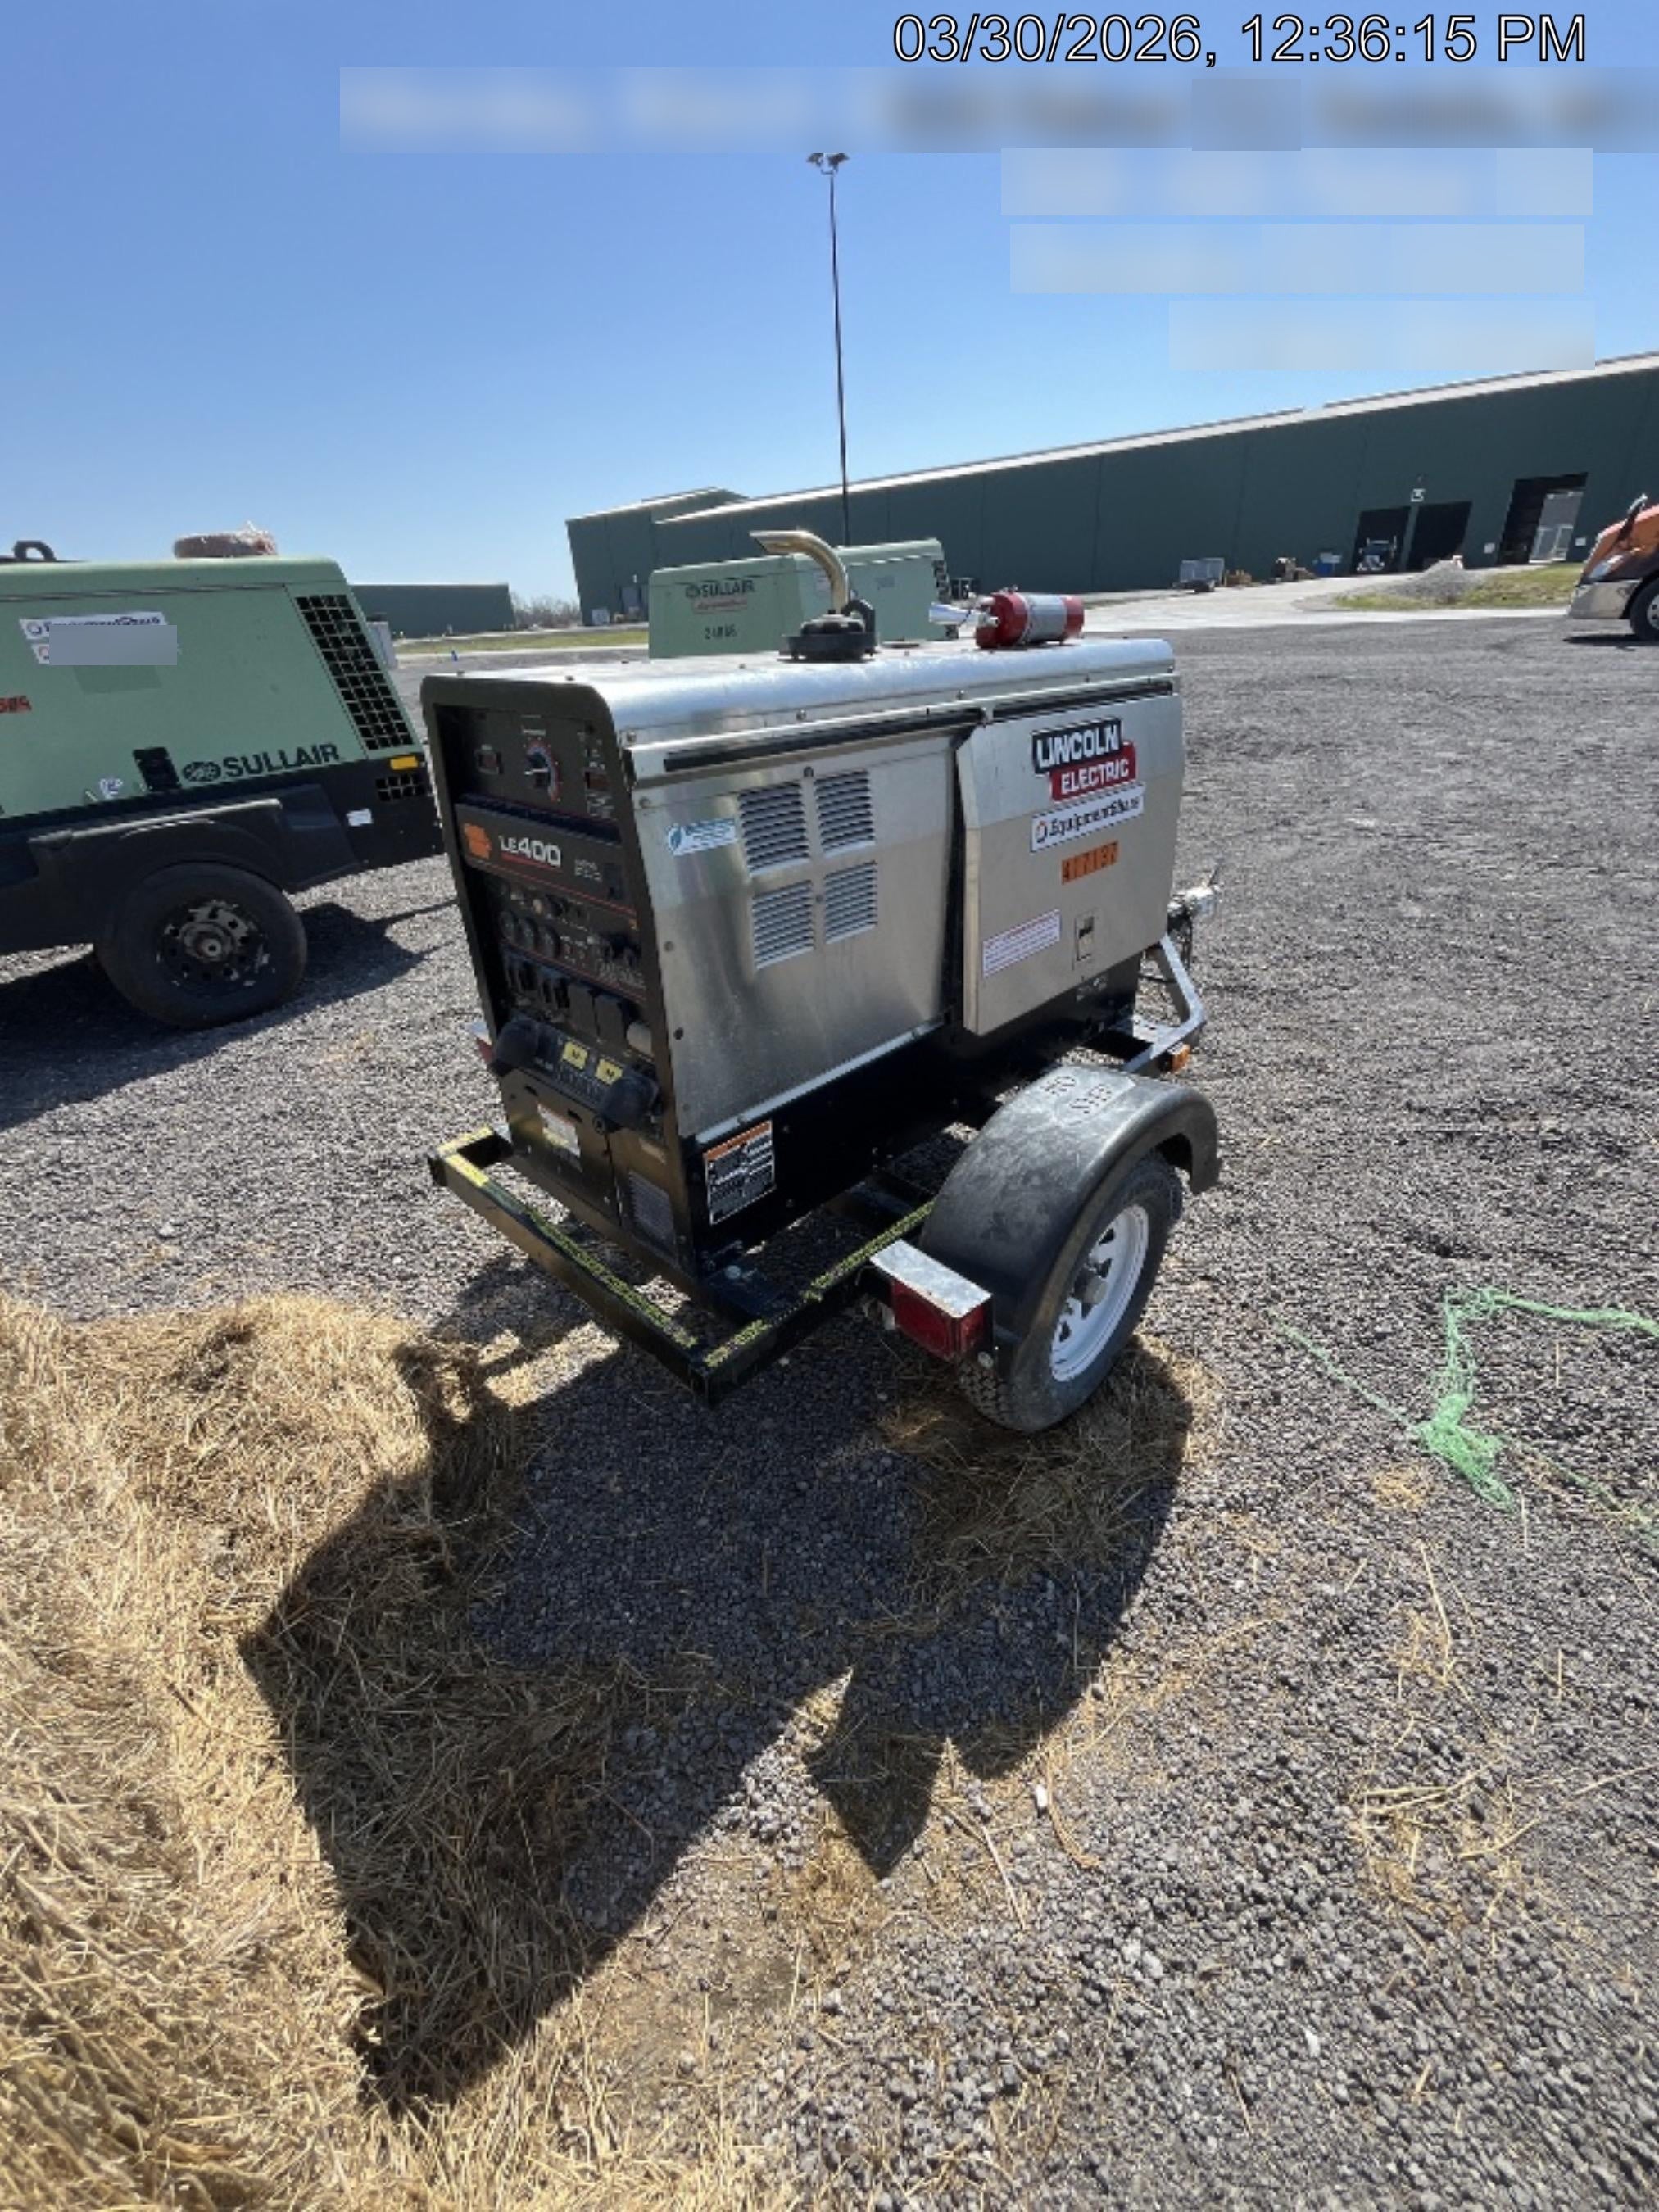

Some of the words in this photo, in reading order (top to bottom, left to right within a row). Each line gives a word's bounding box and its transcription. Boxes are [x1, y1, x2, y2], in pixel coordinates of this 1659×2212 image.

[701, 579, 756, 598] SULLAIR
[222, 742, 341, 777] SULLAIR
[1036, 723, 1120, 768] LINCOLN
[1060, 758, 1130, 796] ELECTRIC
